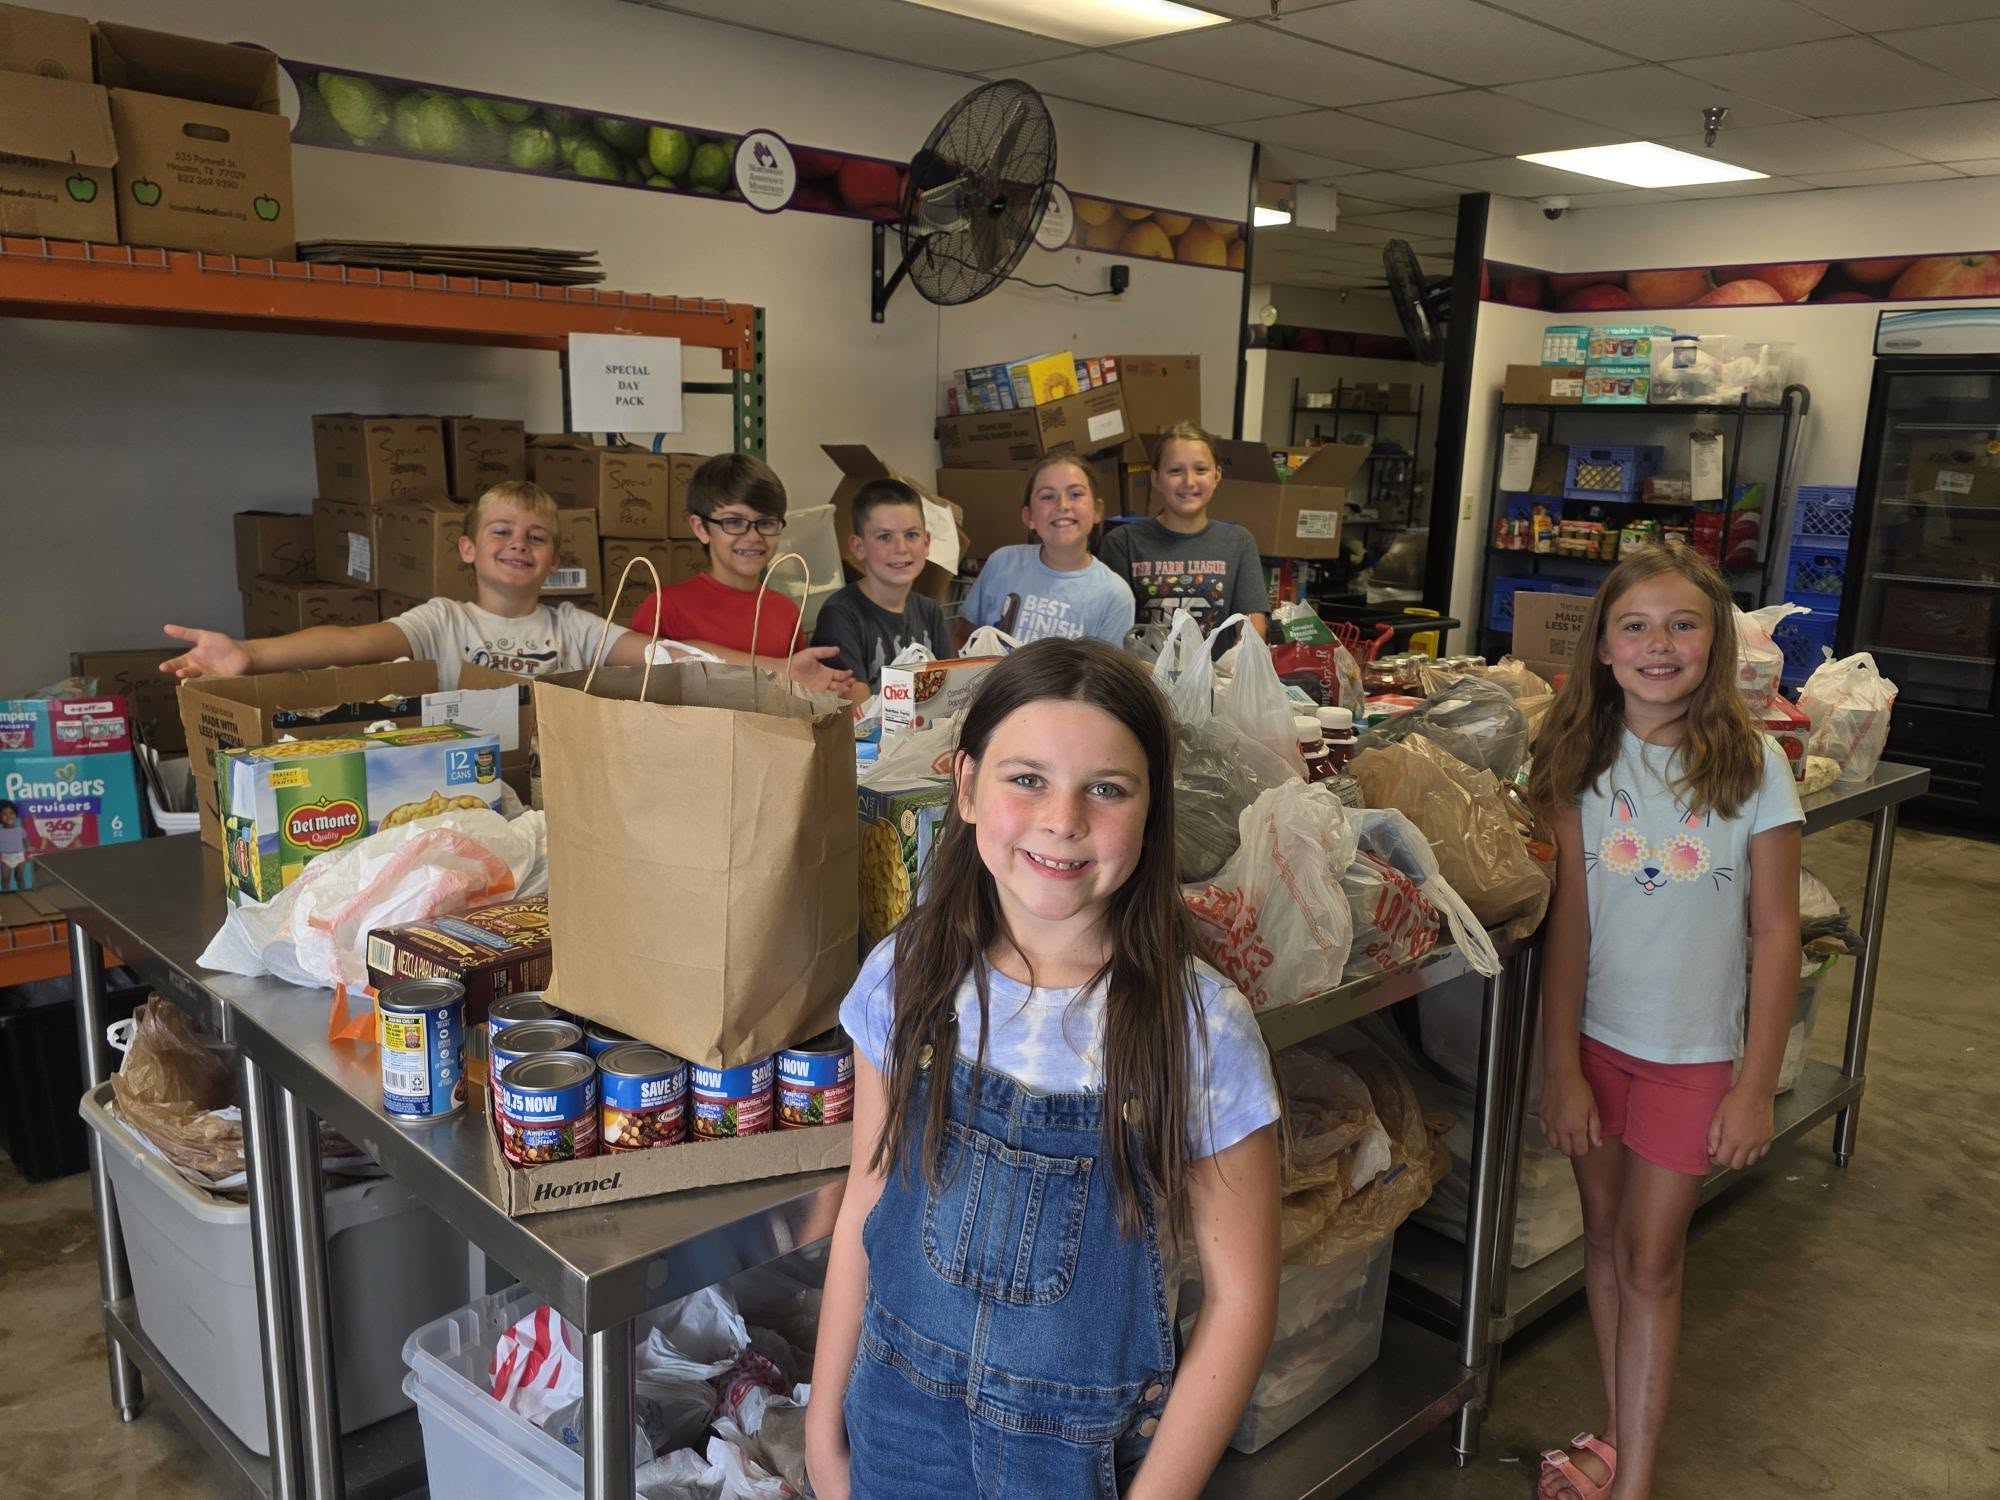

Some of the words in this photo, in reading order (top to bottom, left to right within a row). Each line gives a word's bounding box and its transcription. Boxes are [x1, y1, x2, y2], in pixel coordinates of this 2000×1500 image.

[605, 365, 650, 377] SPECIAL
[618, 381, 641, 391] DAY
[615, 396, 645, 406] PACK
[1187, 560, 1226, 575] LEAGUE
[1023, 593, 1071, 619] BEST
[1017, 610, 1084, 640] FINISH
[1544, 621, 1569, 631] LESS
[1554, 612, 1585, 624] MADE
[491, 655, 540, 673] HOT
[883, 685, 910, 701] Chex
[0, 711, 37, 724] mpers
[200, 713, 220, 728] MADE
[220, 718, 239, 735] WITH
[0, 723, 31, 733] ruisers
[199, 724, 214, 740] LESS
[451, 751, 470, 770] 12
[450, 770, 471, 780] CANS
[6, 772, 105, 802] Pampers
[28, 801, 92, 814] cruisers
[111, 815, 123, 831] 6
[291, 818, 313, 835] Del
[315, 811, 358, 830] Monte
[311, 830, 340, 843] Quality
[397, 948, 419, 980] MEZCLA
[418, 957, 433, 980] PARA
[751, 1062, 772, 1085] SAVE
[783, 1058, 810, 1078] NOW
[696, 1069, 723, 1089] NOW
[640, 1078, 671, 1099] SAVE
[524, 1095, 558, 1113] NOW
[533, 1171, 621, 1201] Hormel
